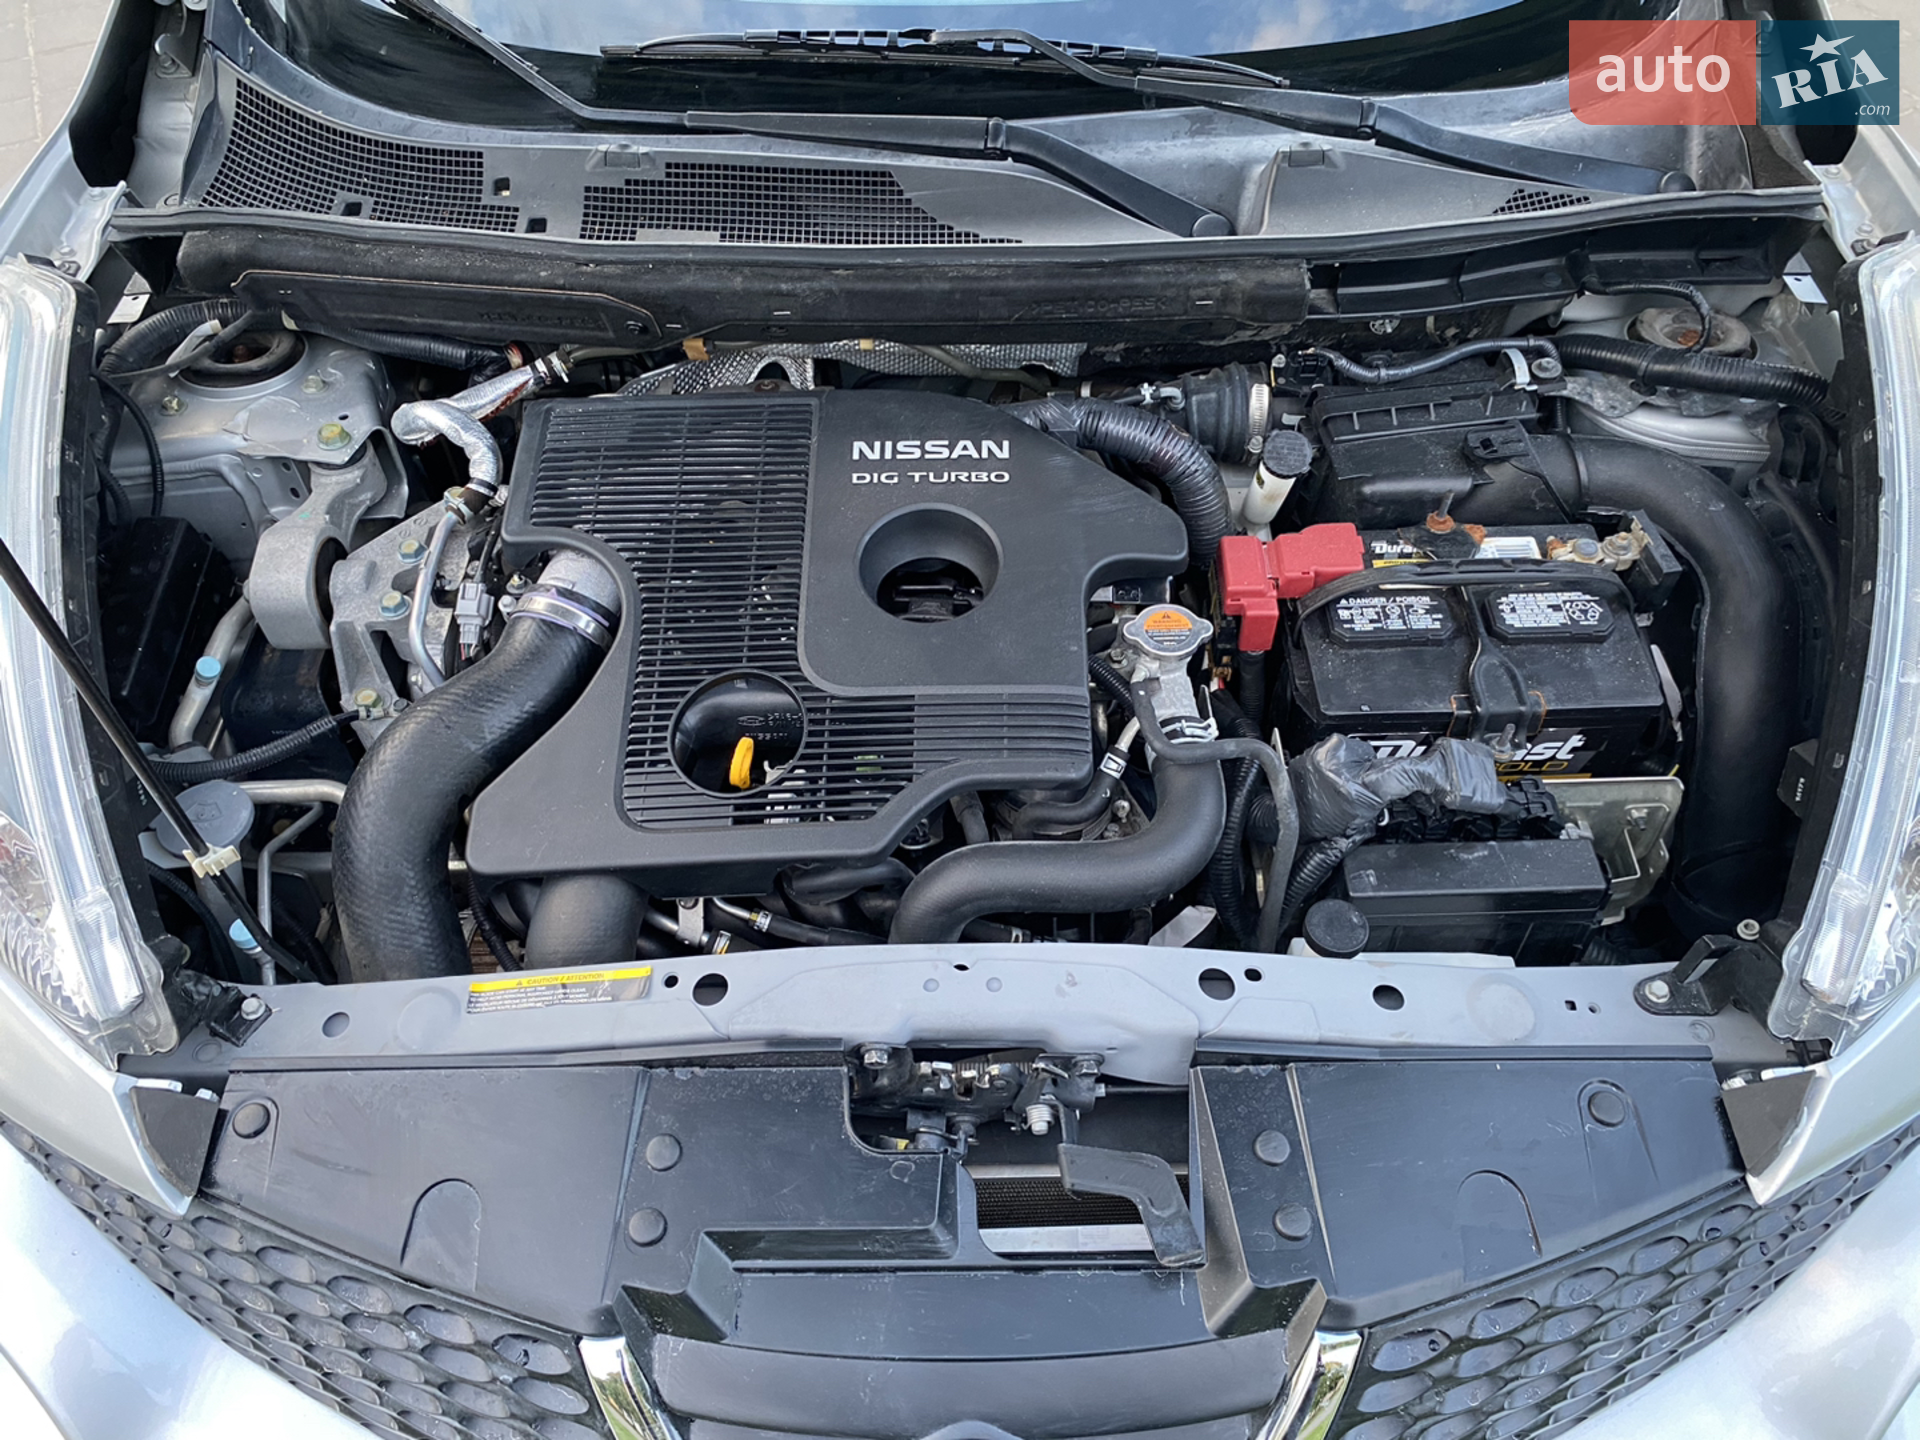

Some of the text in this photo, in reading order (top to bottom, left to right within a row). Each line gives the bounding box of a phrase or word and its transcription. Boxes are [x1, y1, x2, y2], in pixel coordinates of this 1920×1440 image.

[852, 439, 1010, 461] NISSAN
[851, 471, 1010, 484] DIG TURBO
[526, 976, 560, 985] CAUTION
[566, 972, 605, 982] ATTENTION
